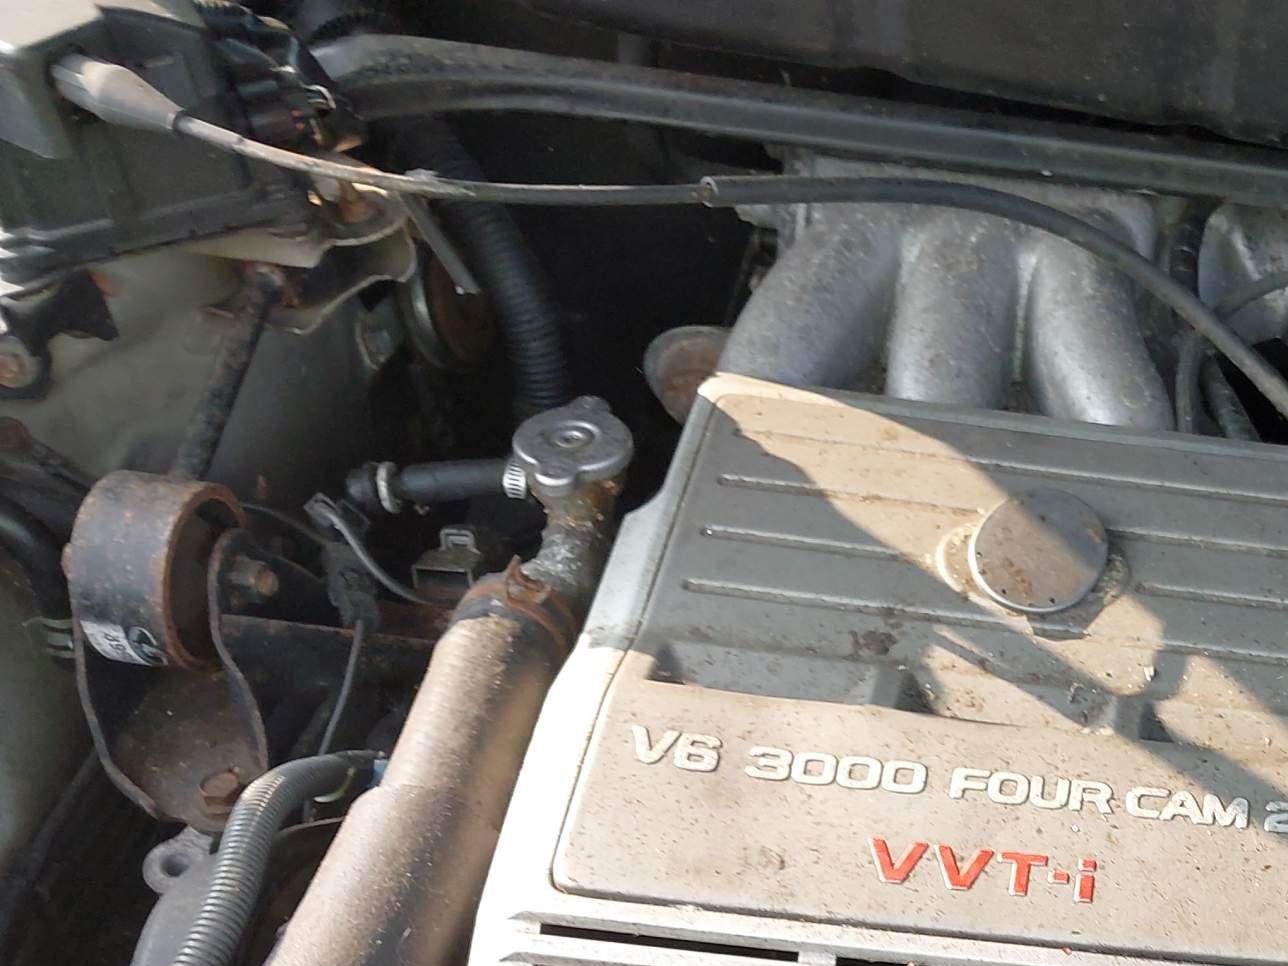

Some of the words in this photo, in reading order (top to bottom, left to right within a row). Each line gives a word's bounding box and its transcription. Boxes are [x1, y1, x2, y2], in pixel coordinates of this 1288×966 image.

[630, 725, 724, 773] V6
[745, 745, 928, 795] 3000
[949, 766, 1114, 815] FOUR
[1125, 786, 1250, 830] CAM
[869, 837, 1099, 905] VVT-i
